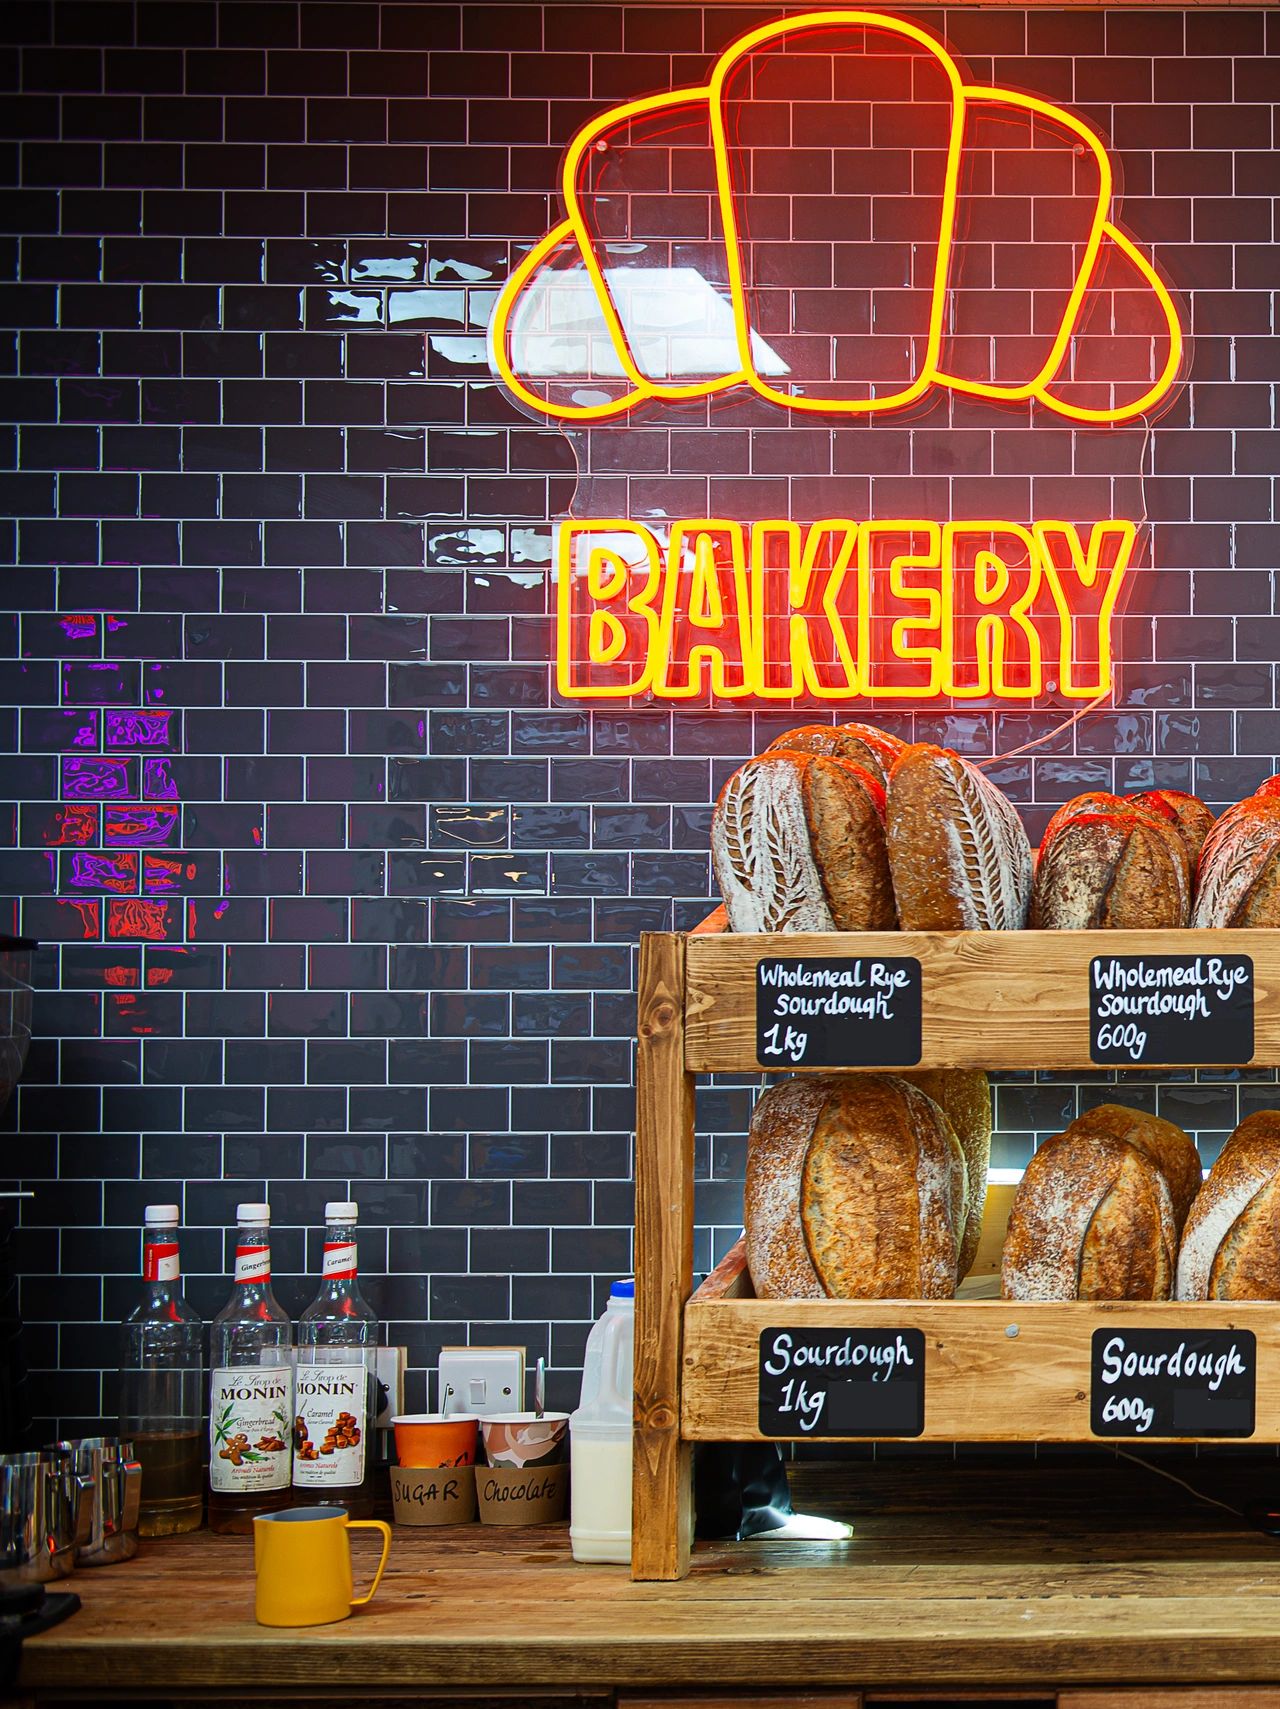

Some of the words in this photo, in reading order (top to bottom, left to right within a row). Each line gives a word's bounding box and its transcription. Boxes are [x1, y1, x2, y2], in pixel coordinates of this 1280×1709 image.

[557, 519, 1136, 698] BAKERY
[761, 960, 866, 988] Wholemeal
[870, 963, 911, 999] Rye
[1094, 958, 1208, 992] Wholemeal
[1207, 958, 1249, 1000] Rye
[1097, 1023, 1147, 1060] 600g
[326, 1255, 353, 1267] Caramel
[764, 1334, 914, 1382] Sourdough
[1101, 1337, 1246, 1391] Sourdough
[220, 1385, 286, 1400] MONIN
[778, 1378, 826, 1431] 1kg
[307, 1408, 334, 1418] Caramel
[1102, 1395, 1155, 1432] 600g
[395, 1479, 460, 1506] SUGAR
[484, 1477, 557, 1502] Chocolate
